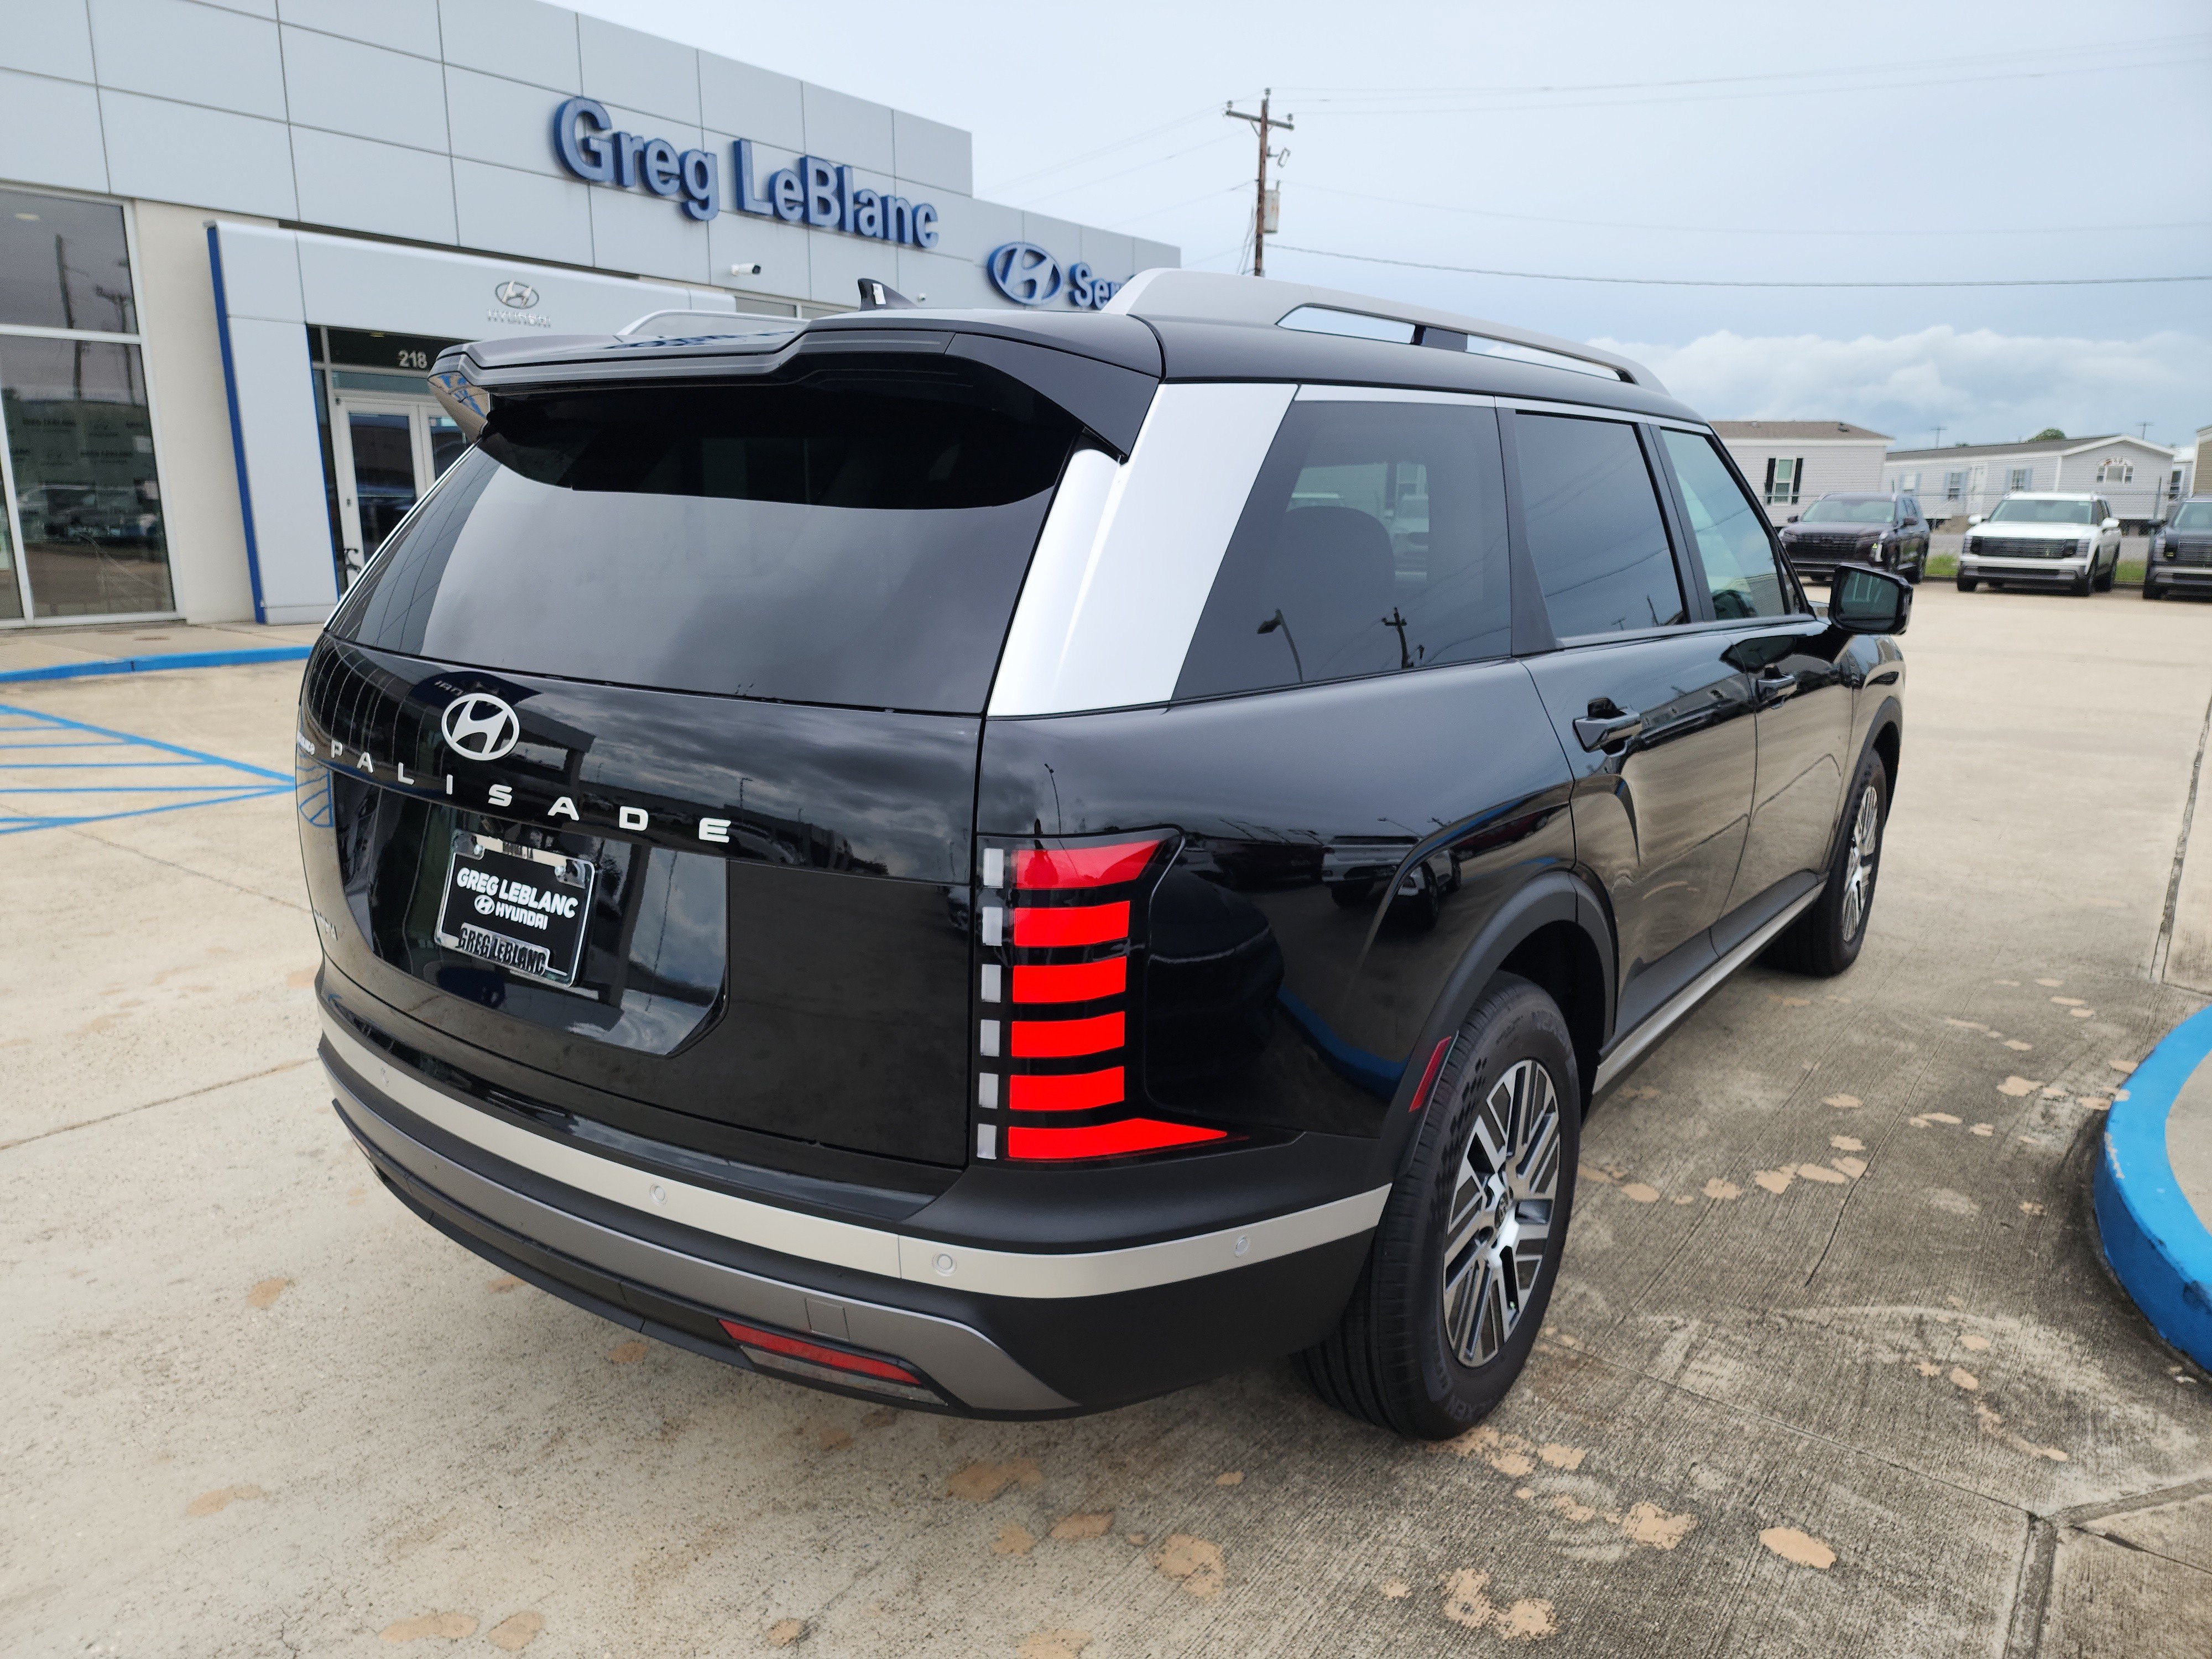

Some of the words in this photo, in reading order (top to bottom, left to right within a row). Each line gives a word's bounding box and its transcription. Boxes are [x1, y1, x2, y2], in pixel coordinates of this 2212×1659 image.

[552, 96, 719, 221] Greg
[732, 138, 939, 248] LeBlanc
[1068, 262, 1128, 311] Ser
[398, 349, 428, 369] 218
[331, 739, 732, 843] PALISADE
[457, 868, 499, 896] GREG
[499, 879, 578, 919] LEBLANC
[495, 901, 549, 930] HYUNDAI
[458, 927, 492, 959] GREG
